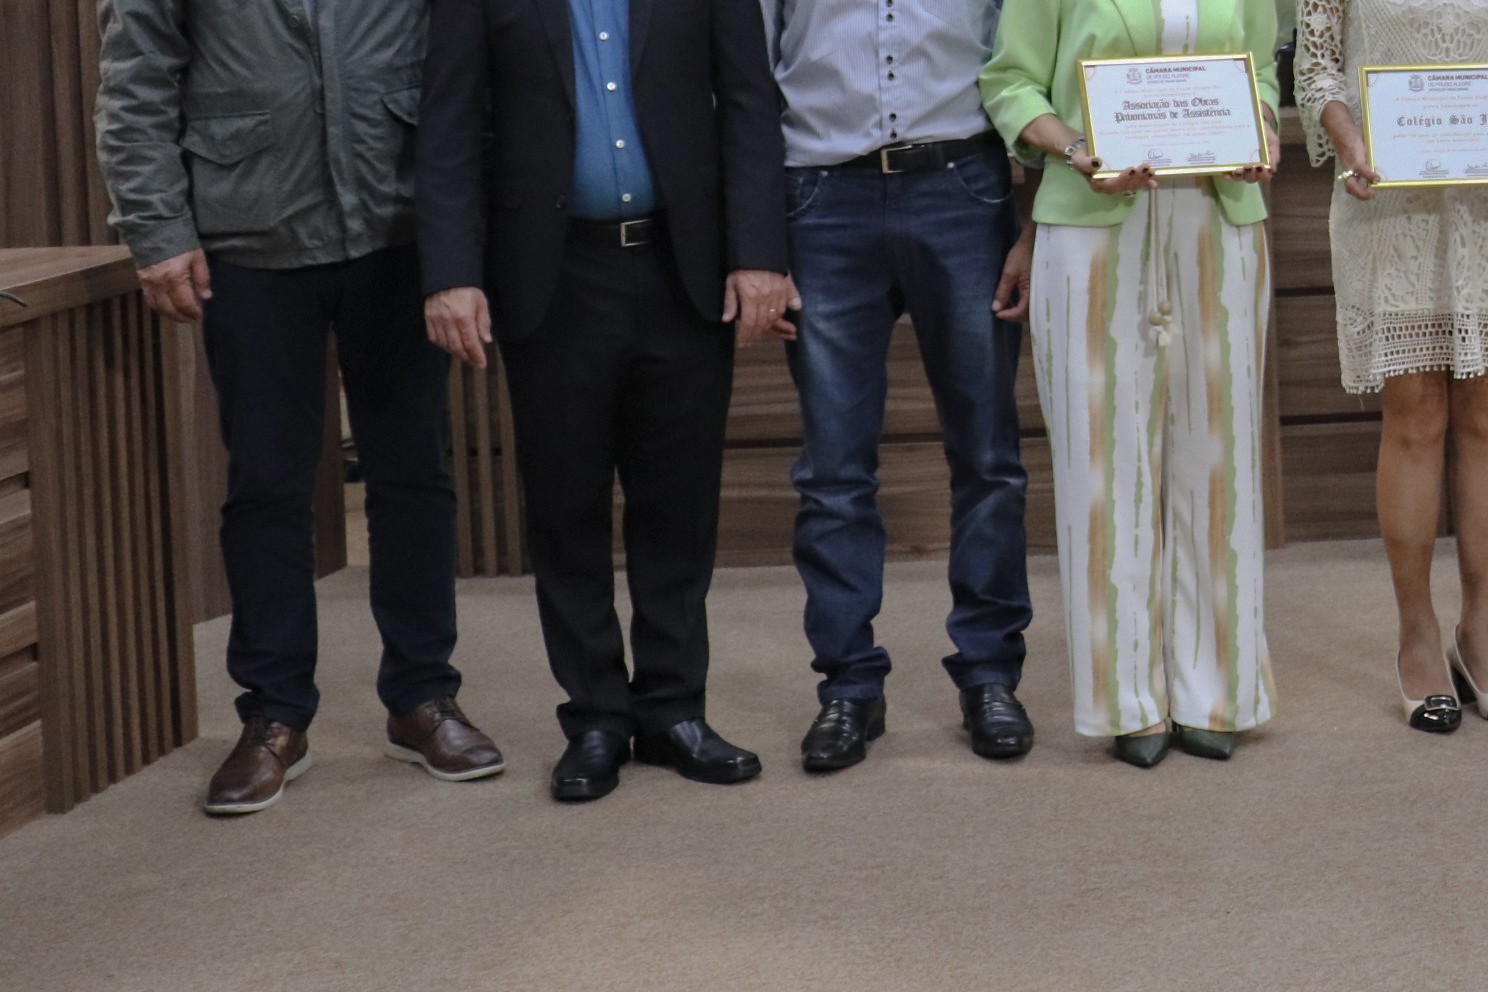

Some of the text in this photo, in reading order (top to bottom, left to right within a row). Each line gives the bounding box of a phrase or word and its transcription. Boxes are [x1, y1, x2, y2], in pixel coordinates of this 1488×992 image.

[1123, 97, 1219, 111] Associação das Obras
[1169, 110, 1178, 119] de
[1182, 107, 1231, 118] Assistência
[1396, 115, 1442, 127] Colégio
[1449, 114, 1473, 125] São
